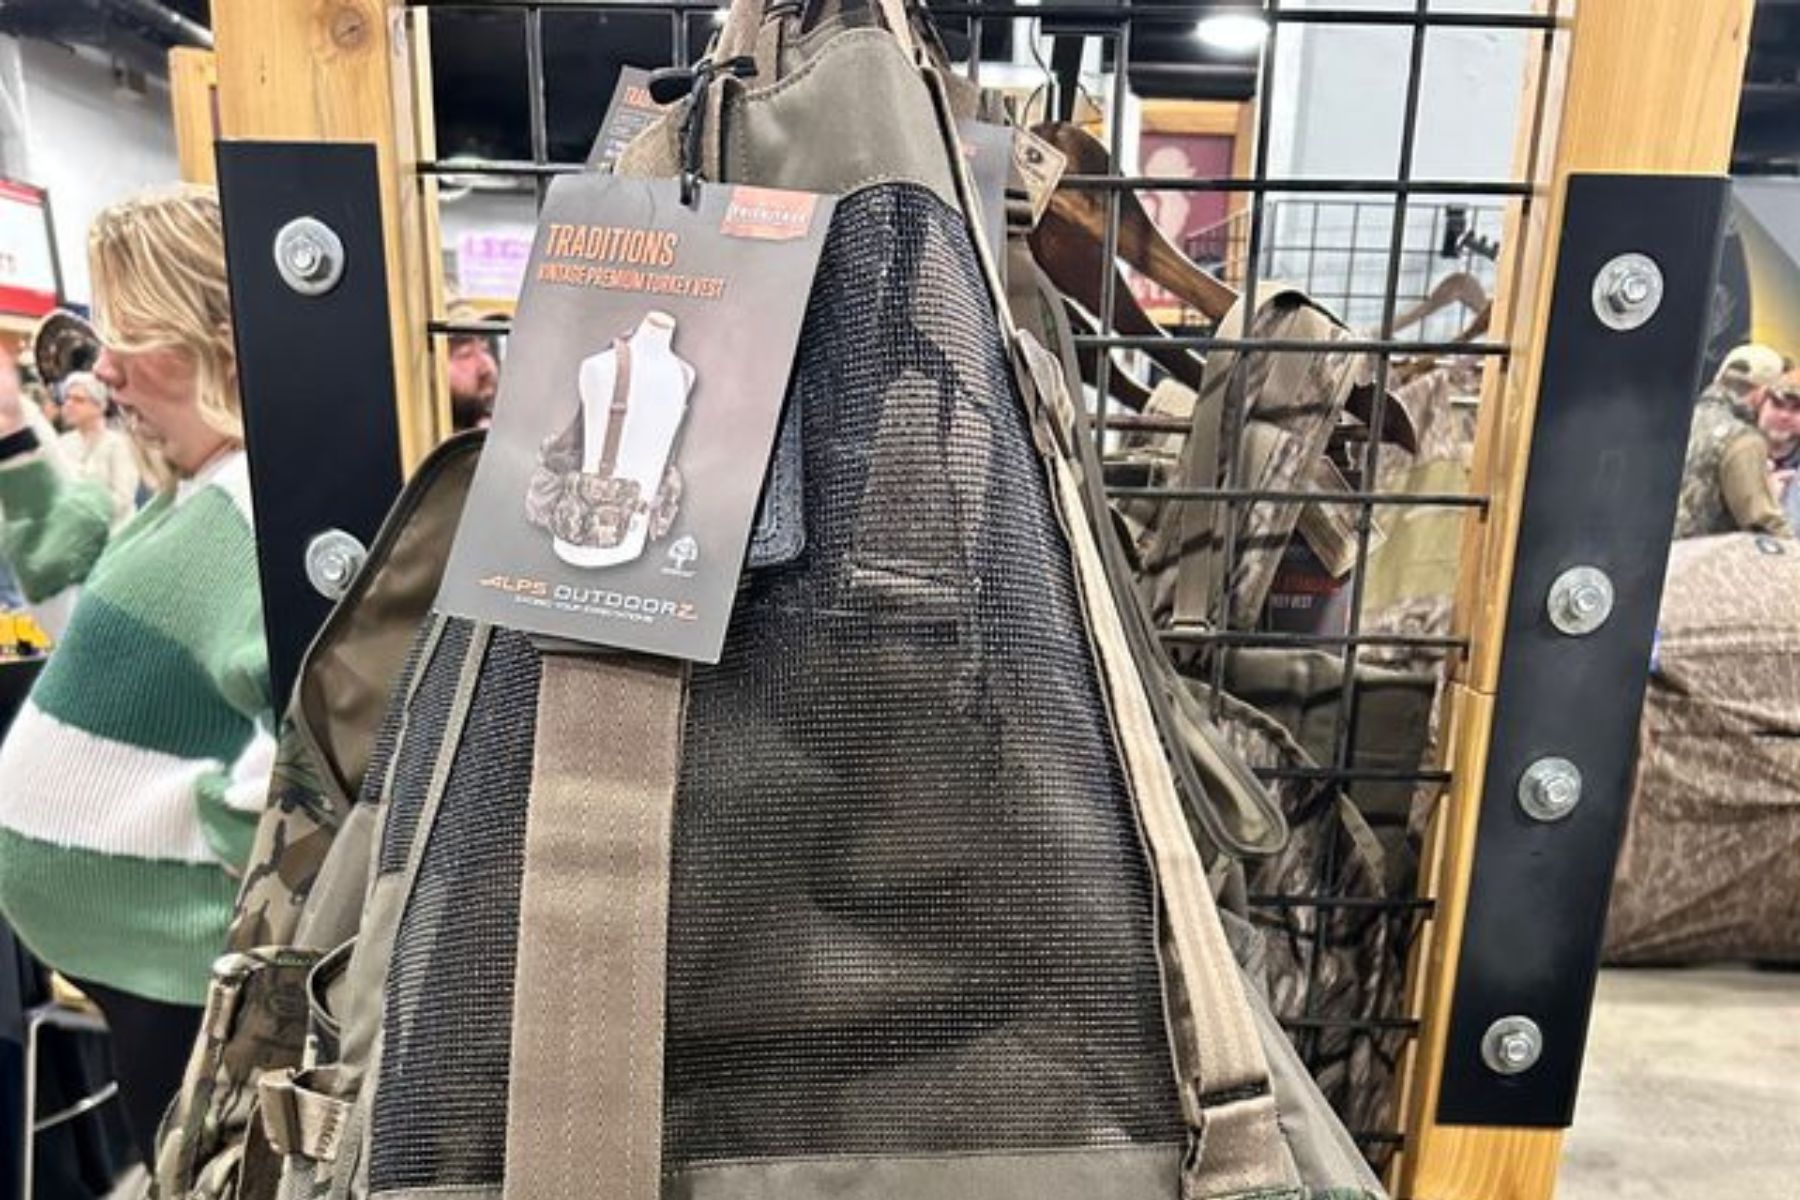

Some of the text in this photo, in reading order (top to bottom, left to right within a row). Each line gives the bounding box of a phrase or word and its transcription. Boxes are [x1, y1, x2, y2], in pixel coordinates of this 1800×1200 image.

[545, 224, 679, 267] TRADITIONS
[478, 575, 549, 597] ALPS
[553, 584, 699, 623] OUTDOORZ
